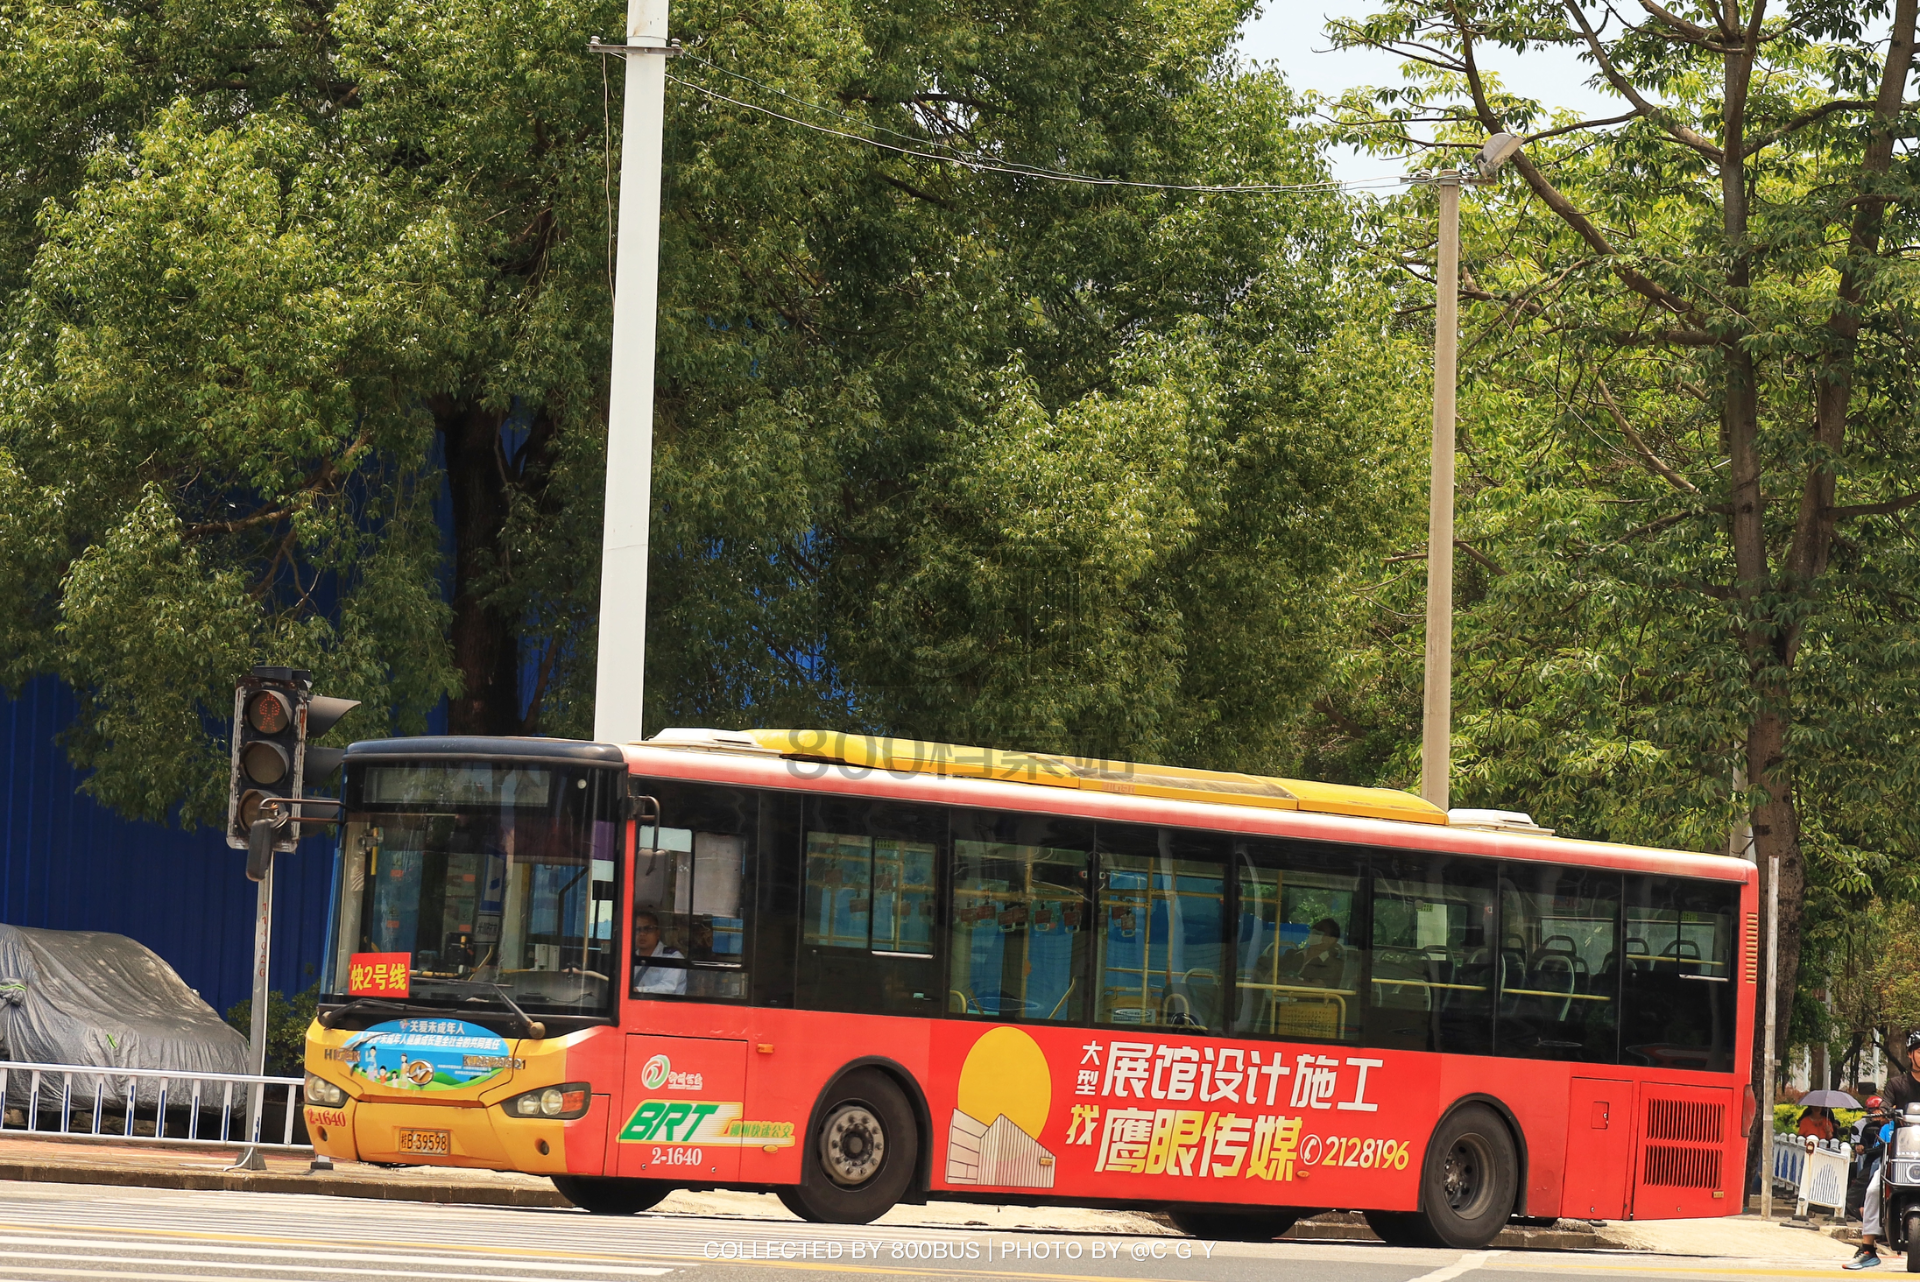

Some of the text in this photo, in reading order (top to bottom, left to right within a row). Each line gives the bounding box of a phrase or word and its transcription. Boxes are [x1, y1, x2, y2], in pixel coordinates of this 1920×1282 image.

[351, 962, 408, 992] 快2号线
[409, 1020, 466, 1035] 关爱未成年人
[1075, 1040, 1103, 1096] 大型
[1101, 1041, 1383, 1112] 展馆设计施工
[307, 1108, 346, 1128] 2-1640
[619, 1102, 720, 1142] BRT
[651, 1147, 702, 1166] 2-1640
[1321, 1136, 1410, 1171] 2128196
